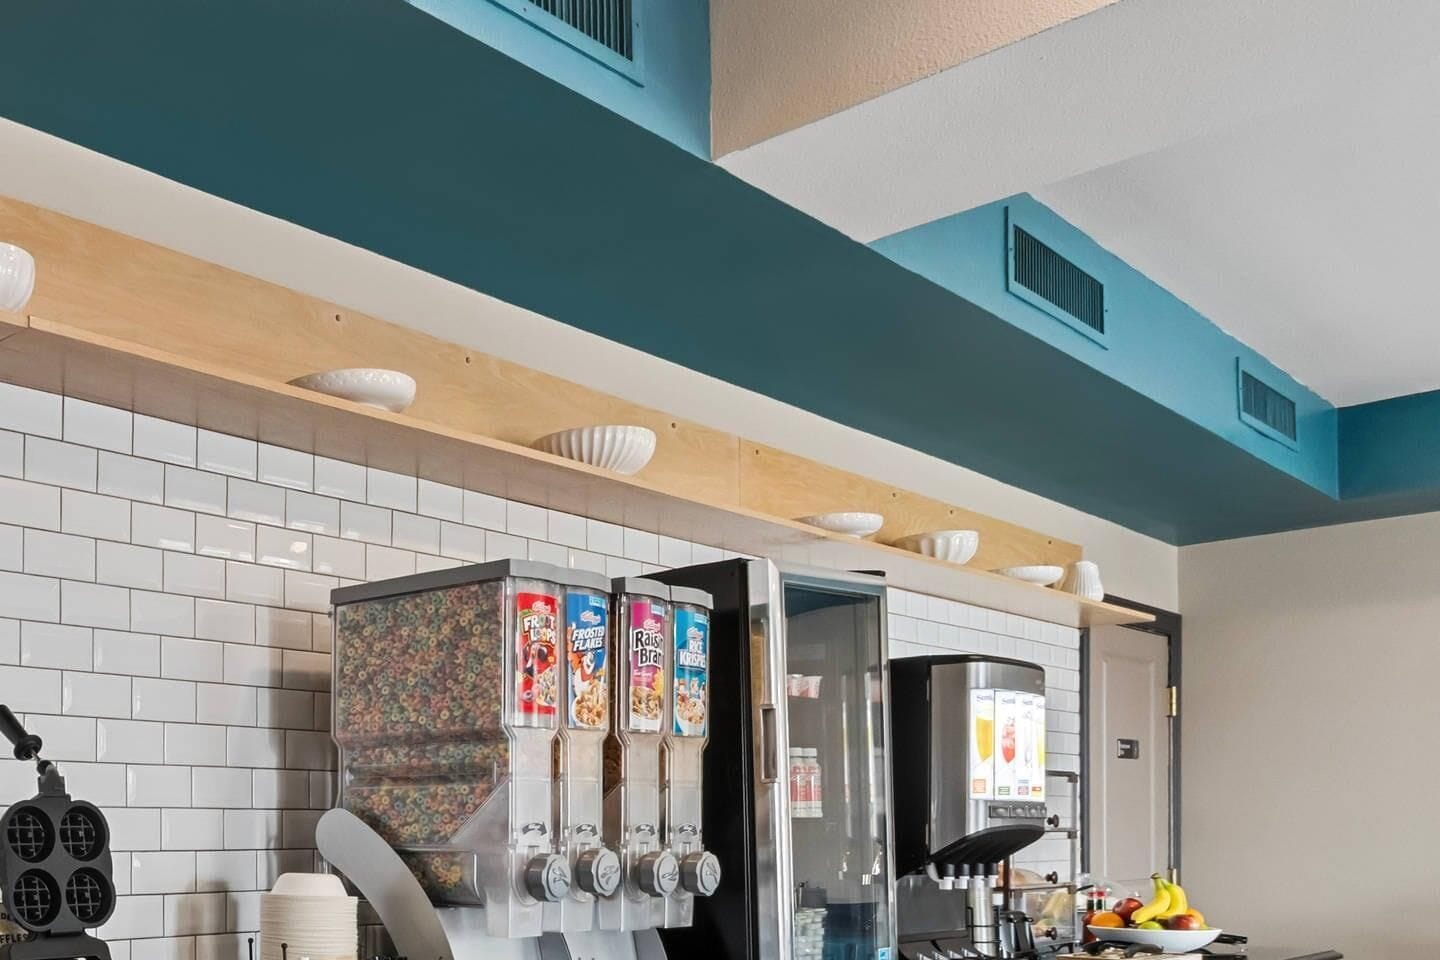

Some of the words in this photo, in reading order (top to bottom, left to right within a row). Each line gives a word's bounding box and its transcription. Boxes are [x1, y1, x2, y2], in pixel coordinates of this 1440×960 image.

[523, 614, 556, 632] FROOT
[530, 628, 556, 645] LOOPS
[573, 637, 603, 652] FLAKES
[635, 630, 663, 649] Rais
